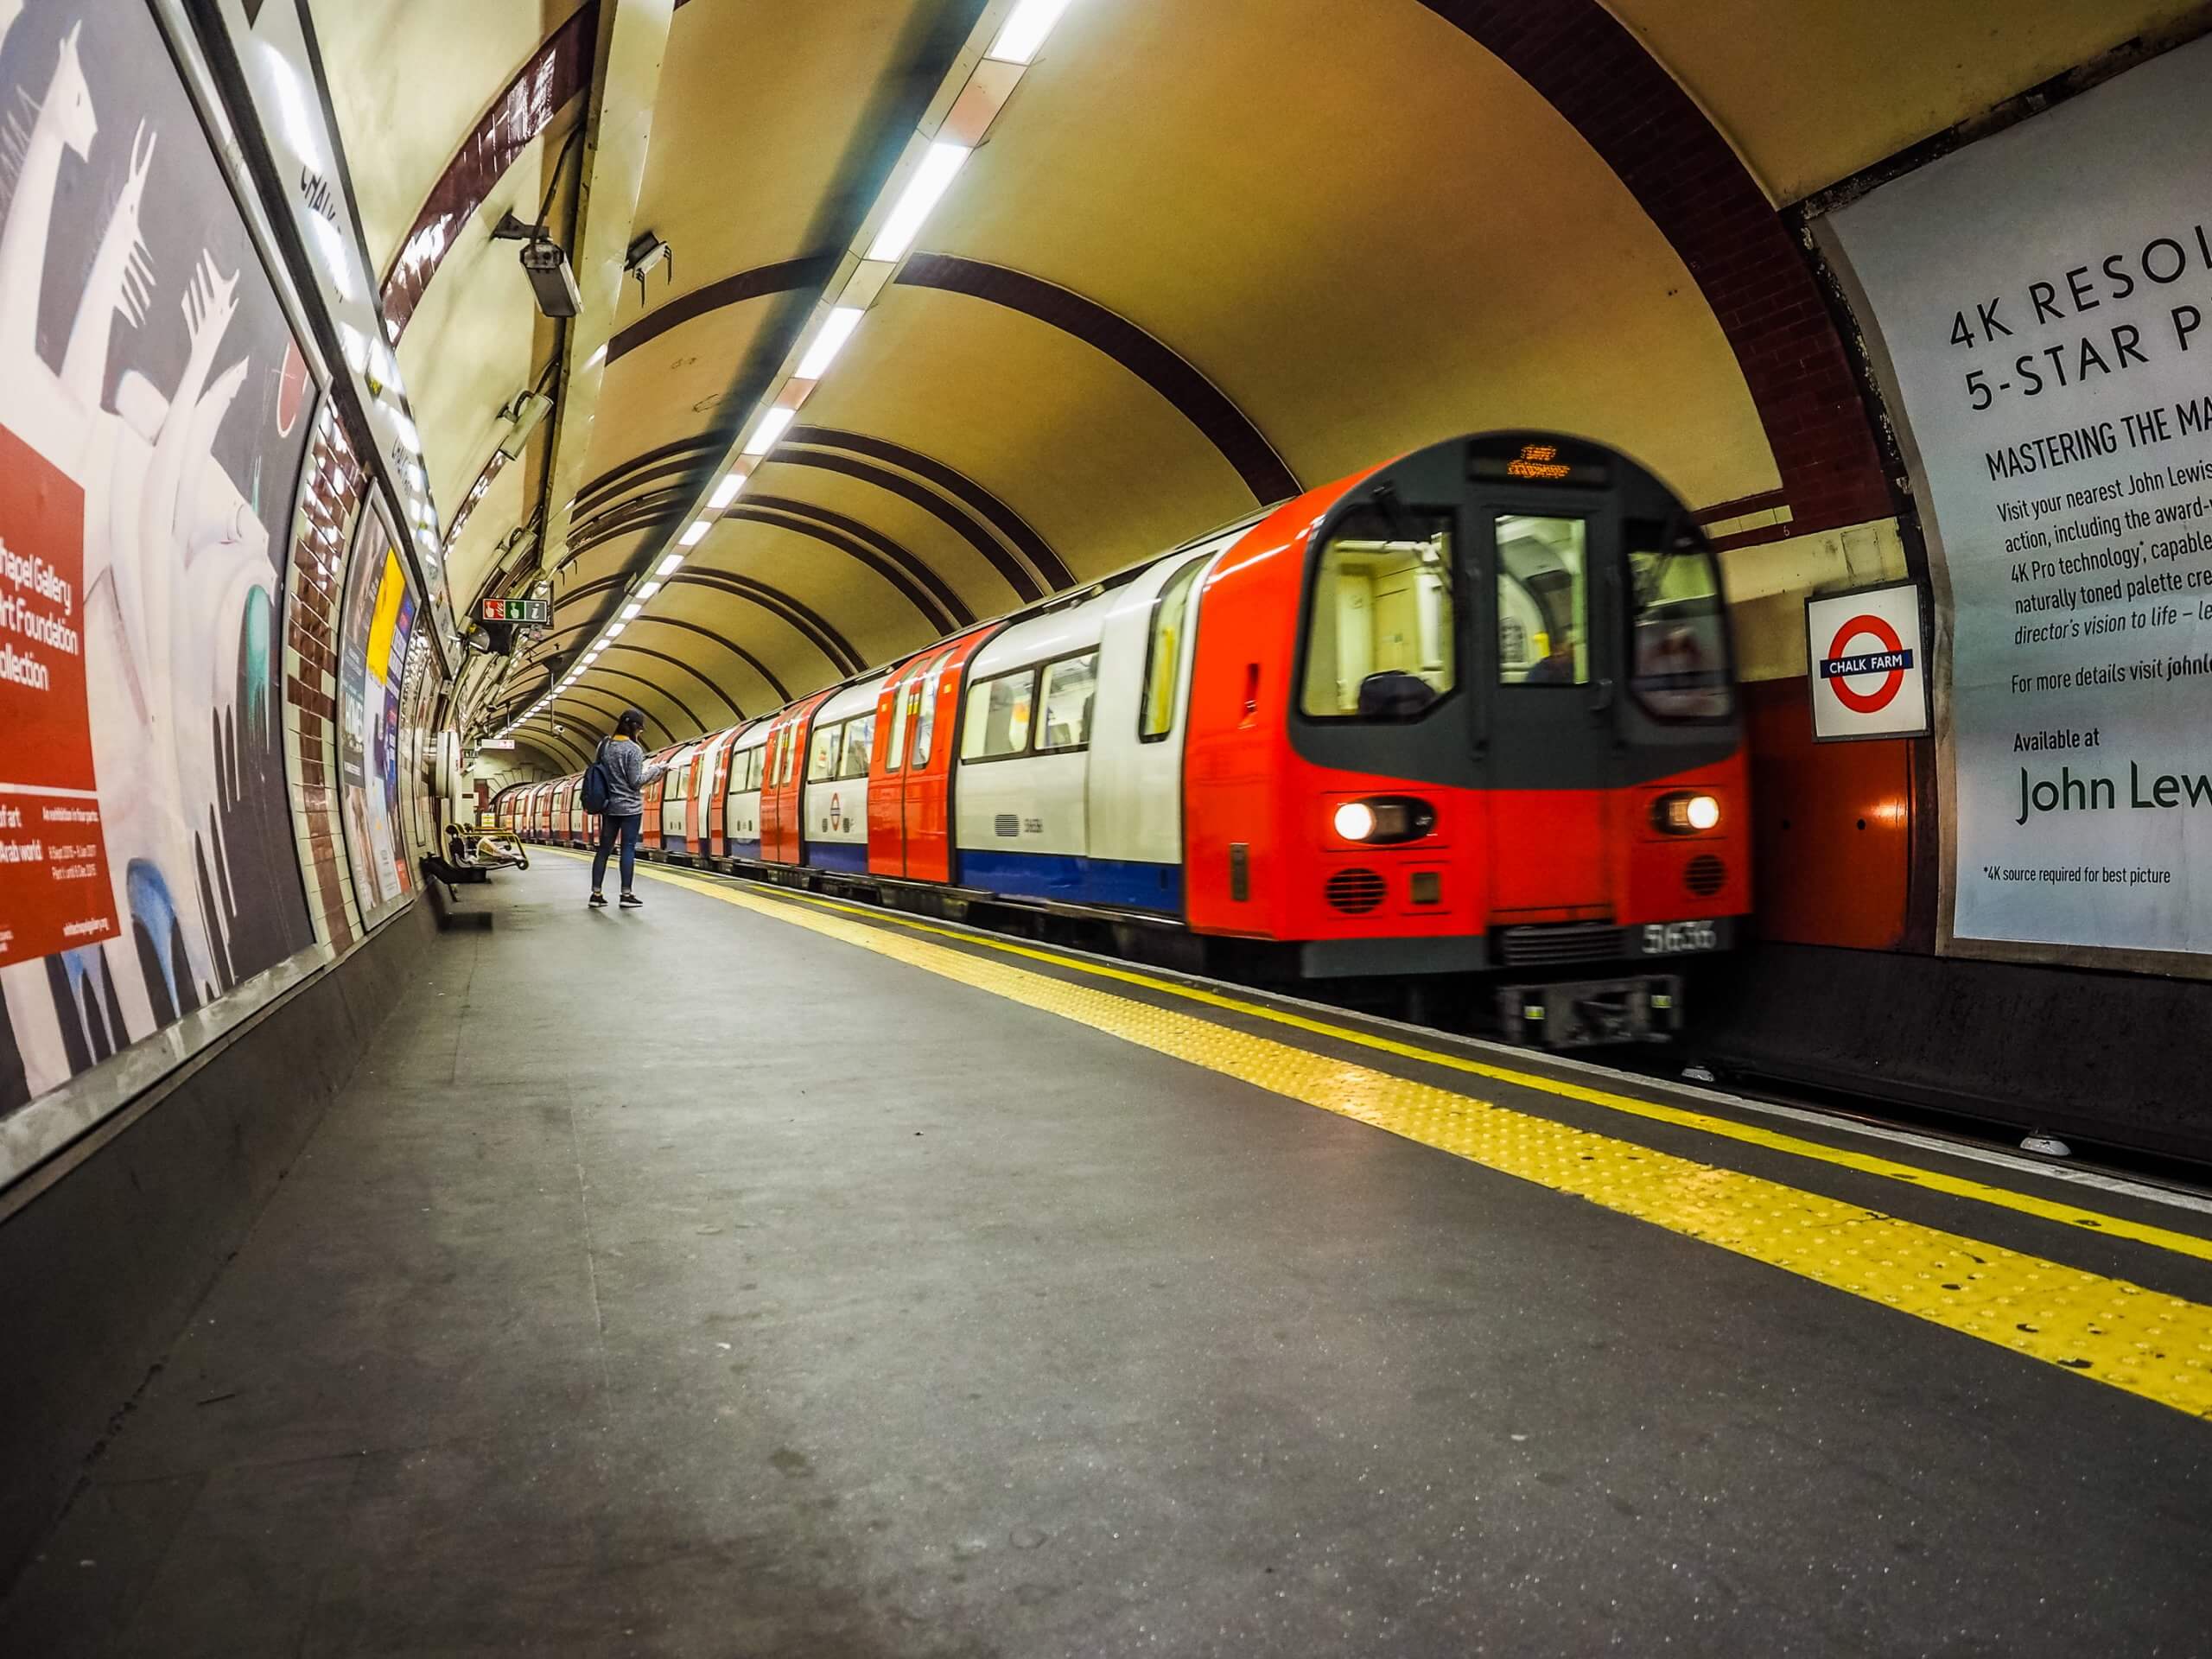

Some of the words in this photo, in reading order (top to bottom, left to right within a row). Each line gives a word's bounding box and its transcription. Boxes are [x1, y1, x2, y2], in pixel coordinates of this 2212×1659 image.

[1949, 296, 2014, 349] 4K
[1965, 324, 2150, 410] 5-STAR
[1985, 422, 2118, 481] MASTERING
[2120, 407, 2172, 448] THE
[1996, 499, 2031, 523] Visit
[2031, 495, 2062, 521] your
[2066, 479, 2125, 509] nearest
[2127, 471, 2164, 496] John
[2166, 459, 2212, 487] Lewis
[2005, 531, 2052, 553] action,
[2053, 515, 2122, 544] including
[2124, 508, 2152, 530] the
[2011, 563, 2030, 583] 4K
[2031, 560, 2056, 581] Pro
[2151, 531, 2212, 562] capable
[35, 556, 72, 615] Gallery
[2015, 587, 2077, 614] naturally
[2079, 578, 2123, 604] toned
[2126, 572, 2183, 603] palette
[16, 597, 79, 656] Foundation
[2014, 619, 2080, 645] director's
[2083, 613, 2126, 636] vision
[2131, 611, 2146, 629] to
[2151, 605, 2177, 626] life
[1829, 659, 1867, 674] CHALK
[1871, 654, 1903, 670] FARM
[2012, 674, 2033, 694] For
[2036, 673, 2072, 691] more
[2075, 663, 2126, 687] details
[2129, 658, 2164, 681] visit
[2013, 728, 2081, 753] Available
[2084, 727, 2101, 747] at
[2015, 766, 2115, 826] John
[2003, 869, 2037, 881] source
[2038, 866, 2082, 886] required
[2083, 866, 2100, 882] for
[2102, 866, 2127, 883] best
[2129, 867, 2171, 887] picture
